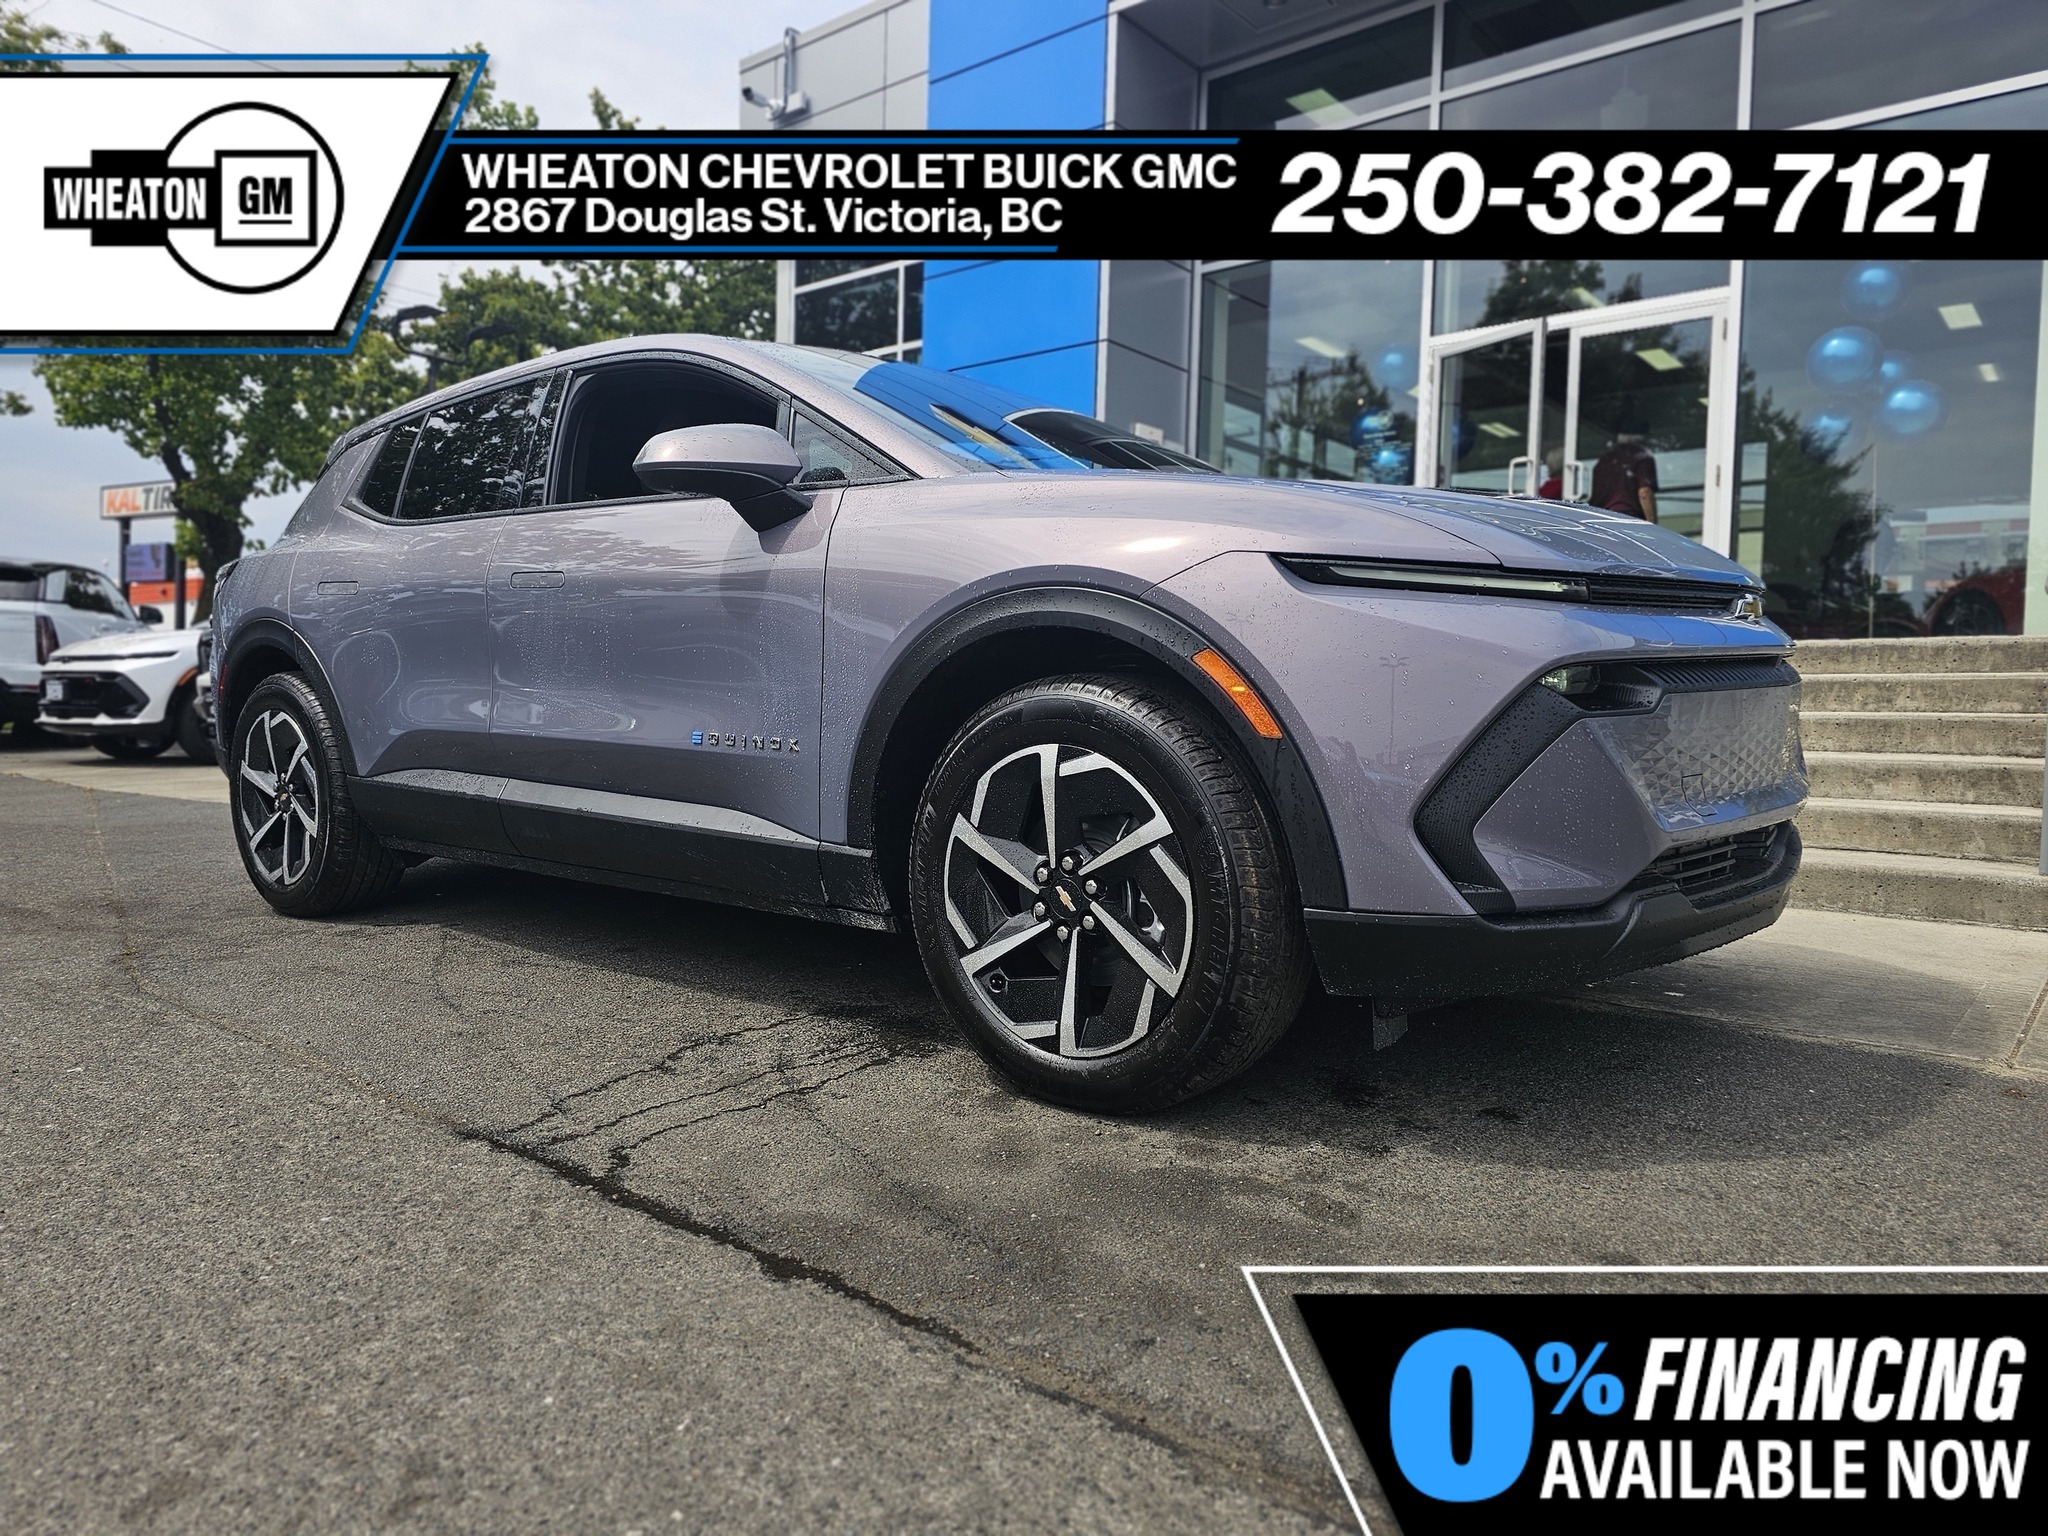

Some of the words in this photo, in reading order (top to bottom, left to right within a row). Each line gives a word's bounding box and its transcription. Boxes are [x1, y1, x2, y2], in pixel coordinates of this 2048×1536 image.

[106, 488, 141, 514] KAL
[143, 485, 172, 512] TIR
[691, 730, 800, 752] EQUINOX
